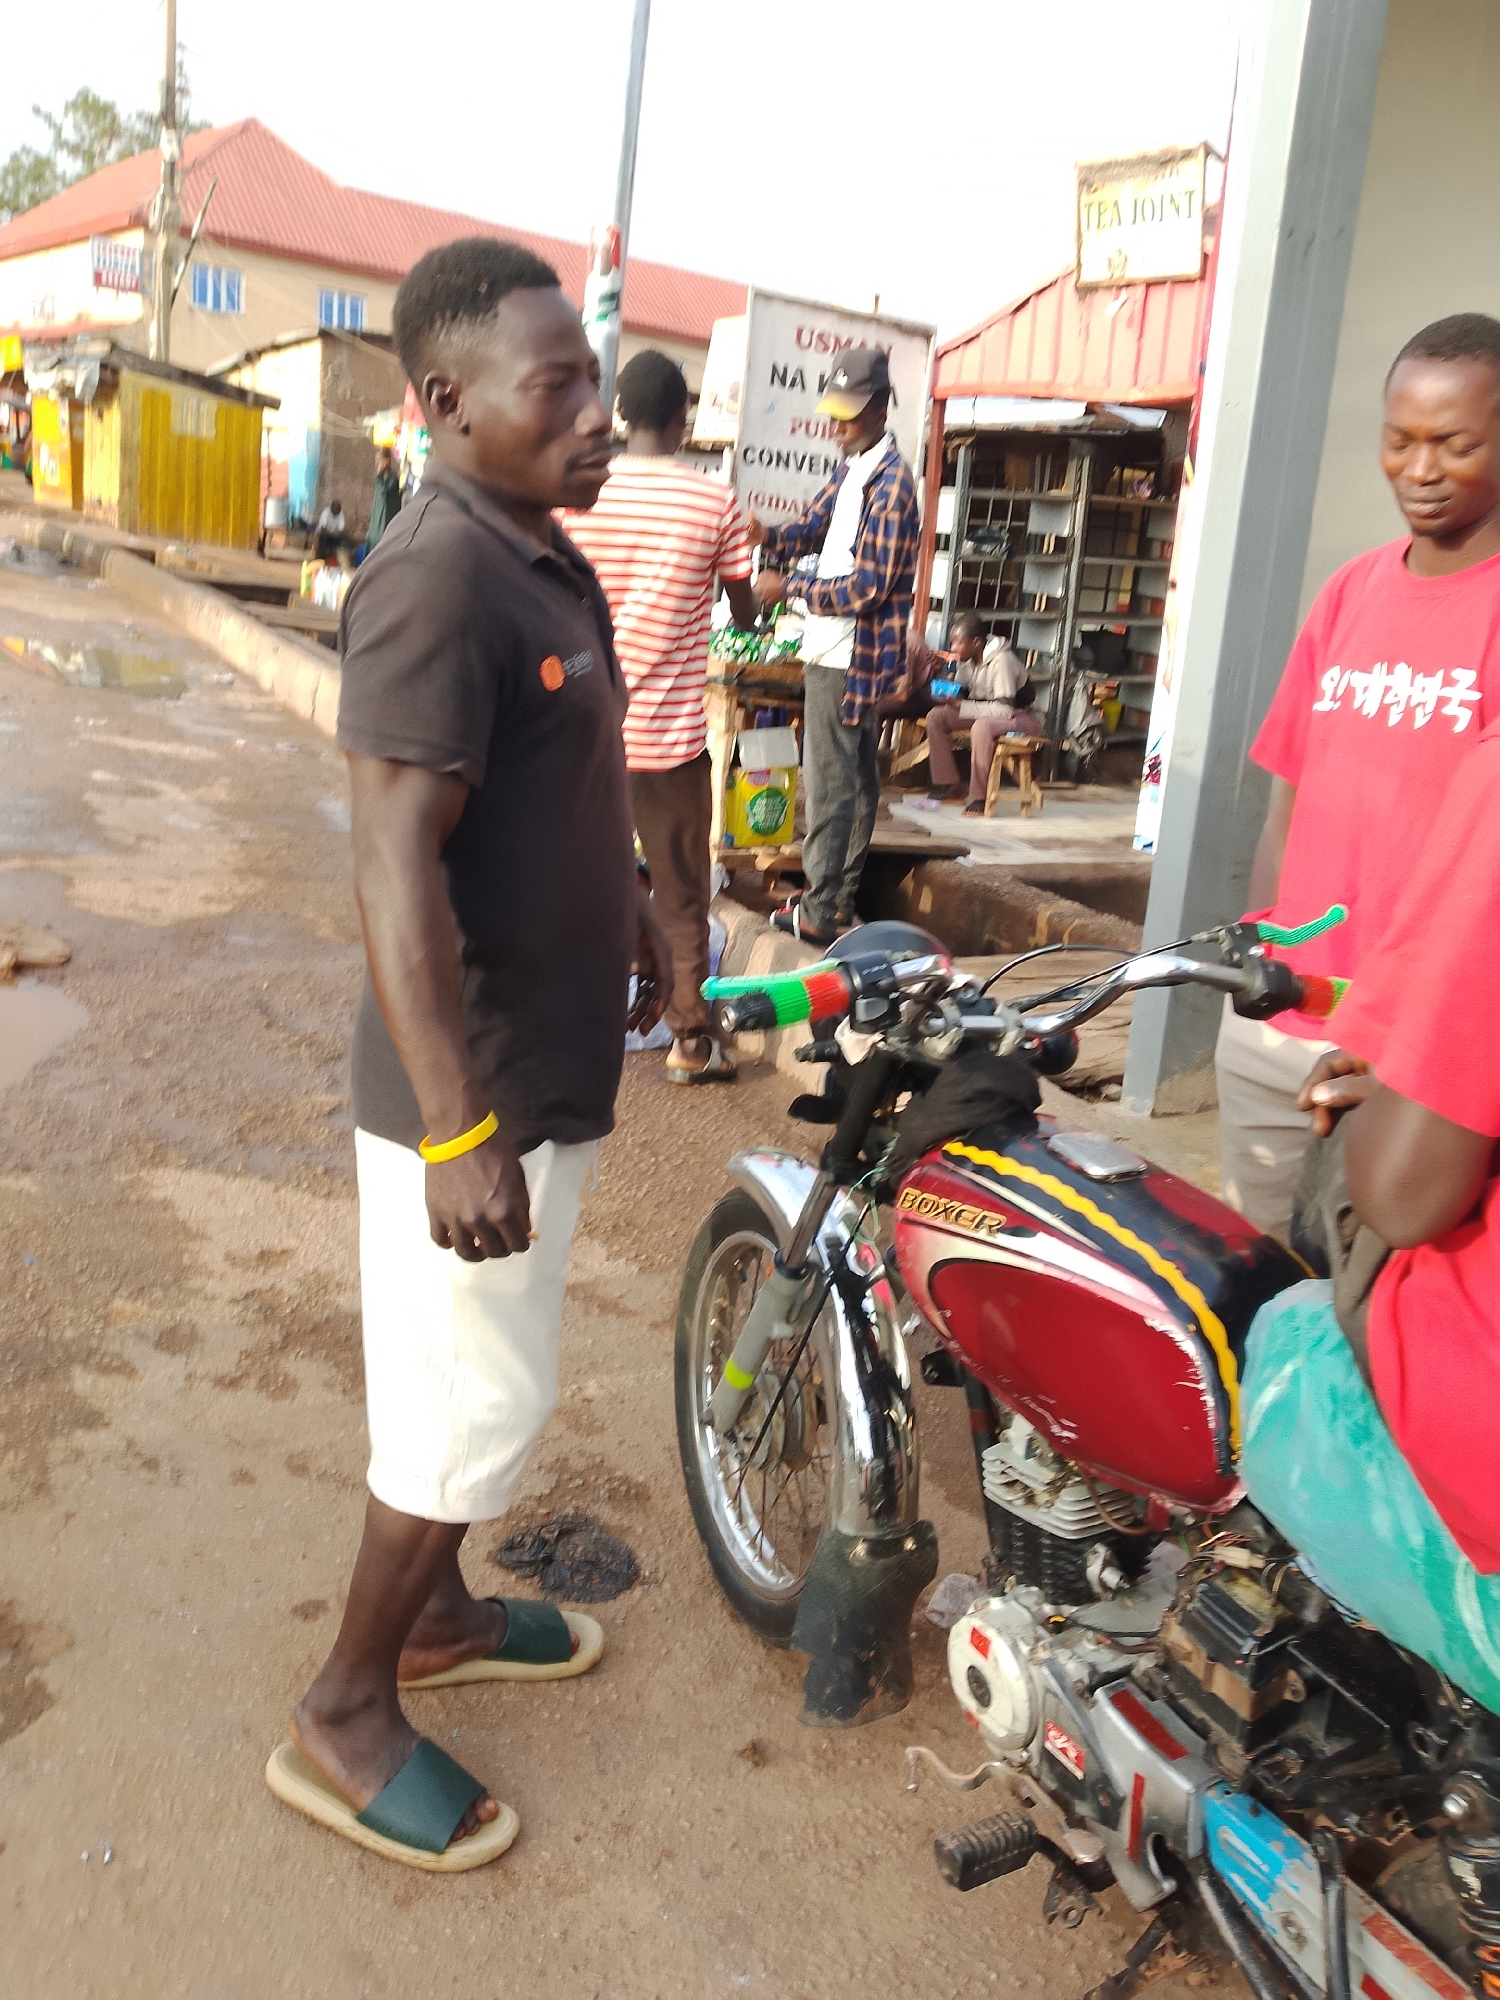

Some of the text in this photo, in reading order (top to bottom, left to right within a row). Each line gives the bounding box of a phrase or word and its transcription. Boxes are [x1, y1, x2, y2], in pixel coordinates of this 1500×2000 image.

[1084, 189, 1196, 231] TEA JOINT
[769, 362, 806, 394] NA
[897, 1186, 1008, 1238] BOXER
